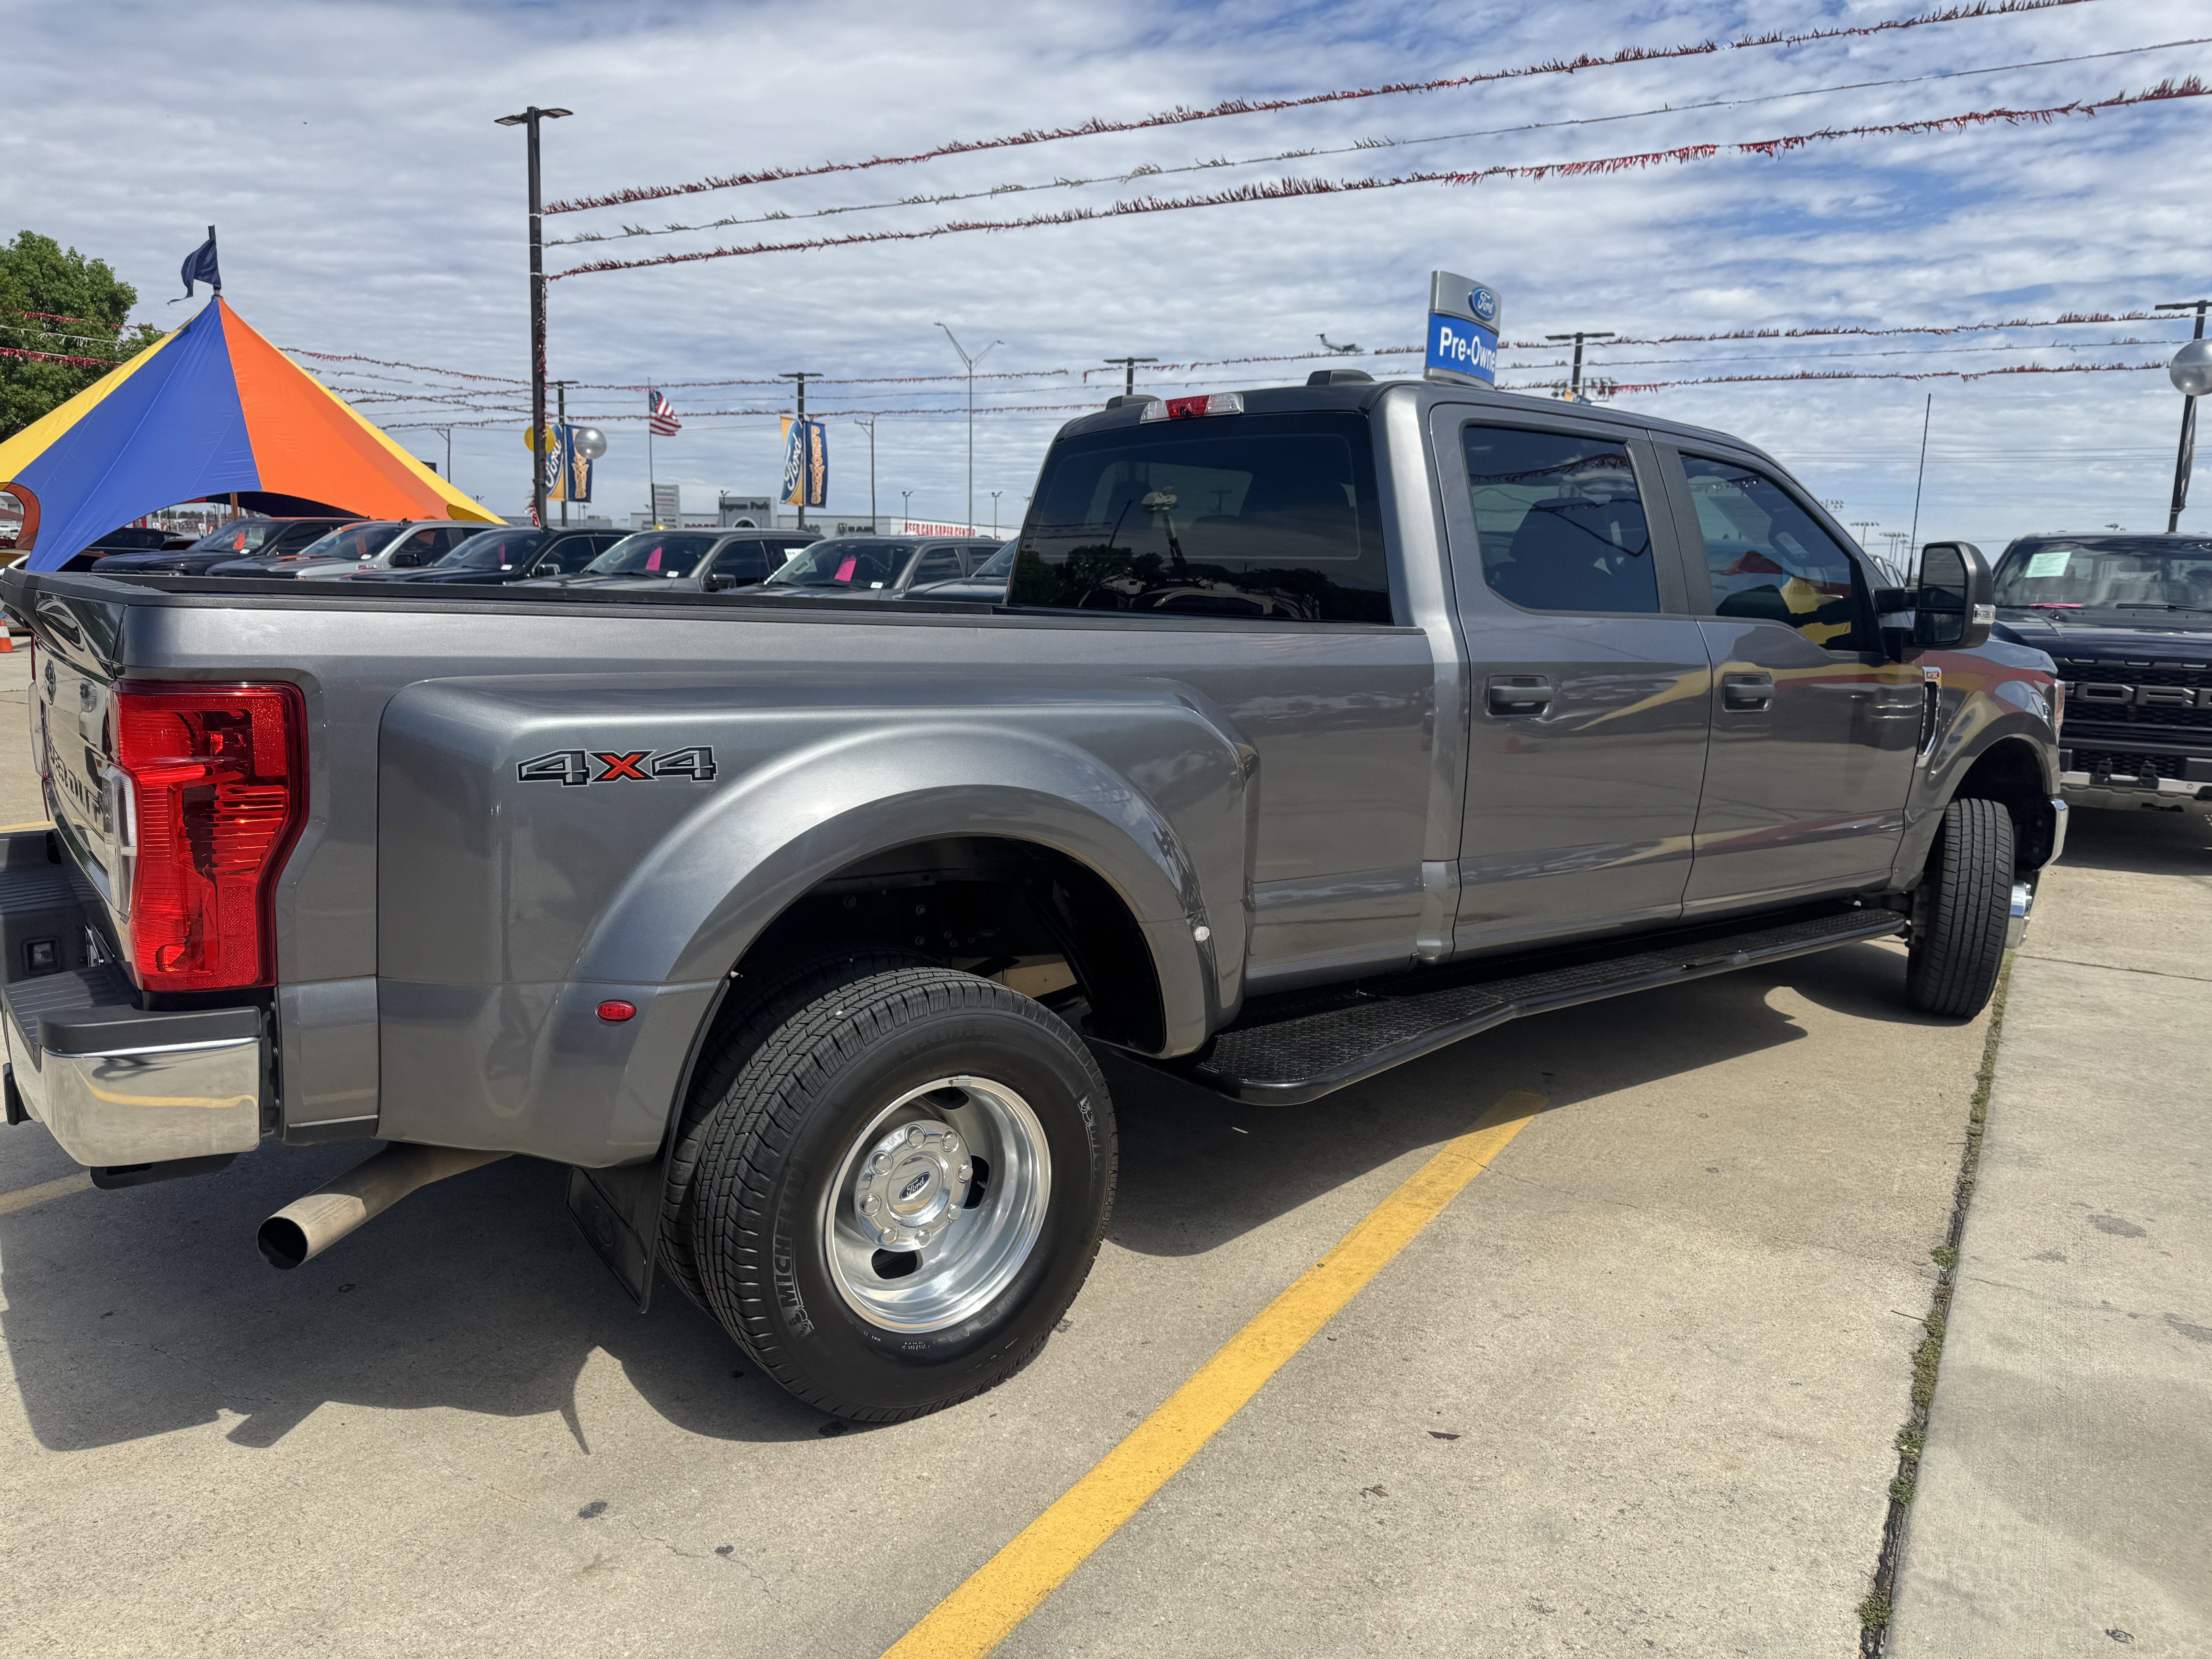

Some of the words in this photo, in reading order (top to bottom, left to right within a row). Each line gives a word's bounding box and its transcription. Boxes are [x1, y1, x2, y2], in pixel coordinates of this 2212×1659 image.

[1477, 291, 1494, 314] Ford
[784, 432, 802, 491] Ford
[954, 526, 975, 538] CENTR
[907, 1176, 925, 1195] Ford
